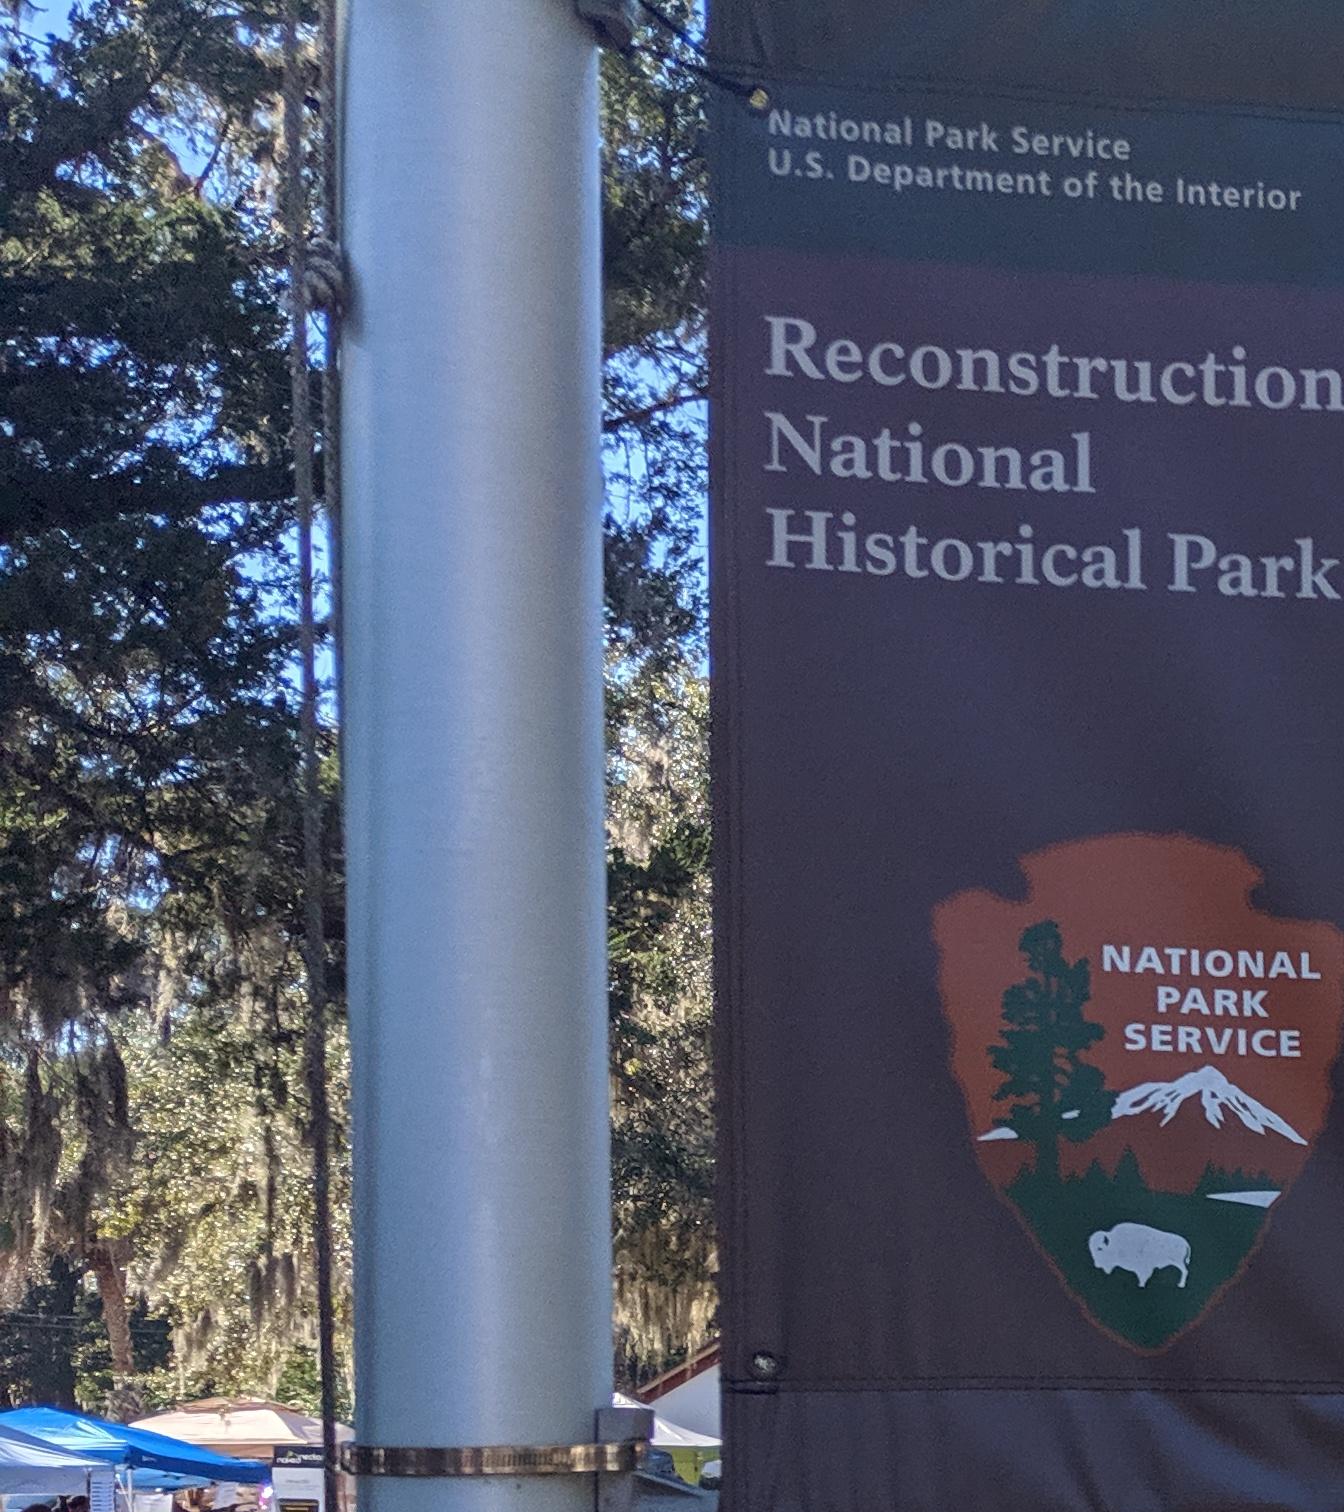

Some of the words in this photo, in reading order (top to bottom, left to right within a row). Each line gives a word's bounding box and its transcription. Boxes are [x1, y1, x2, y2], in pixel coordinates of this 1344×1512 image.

[768, 109, 912, 145] National
[926, 120, 999, 152] Park
[1012, 127, 1131, 160] Service
[768, 148, 834, 179] U.S.
[848, 154, 1051, 198] Department
[1063, 171, 1098, 199] of
[1109, 173, 1163, 203] the
[1176, 178, 1302, 211] Interior
[764, 412, 1096, 493] National
[766, 507, 1147, 589] Historical
[1167, 532, 1341, 599] Park
[1102, 944, 1321, 980] NATIONAL
[1157, 986, 1269, 1018] PARK
[1124, 1023, 1301, 1057] SERVICE
